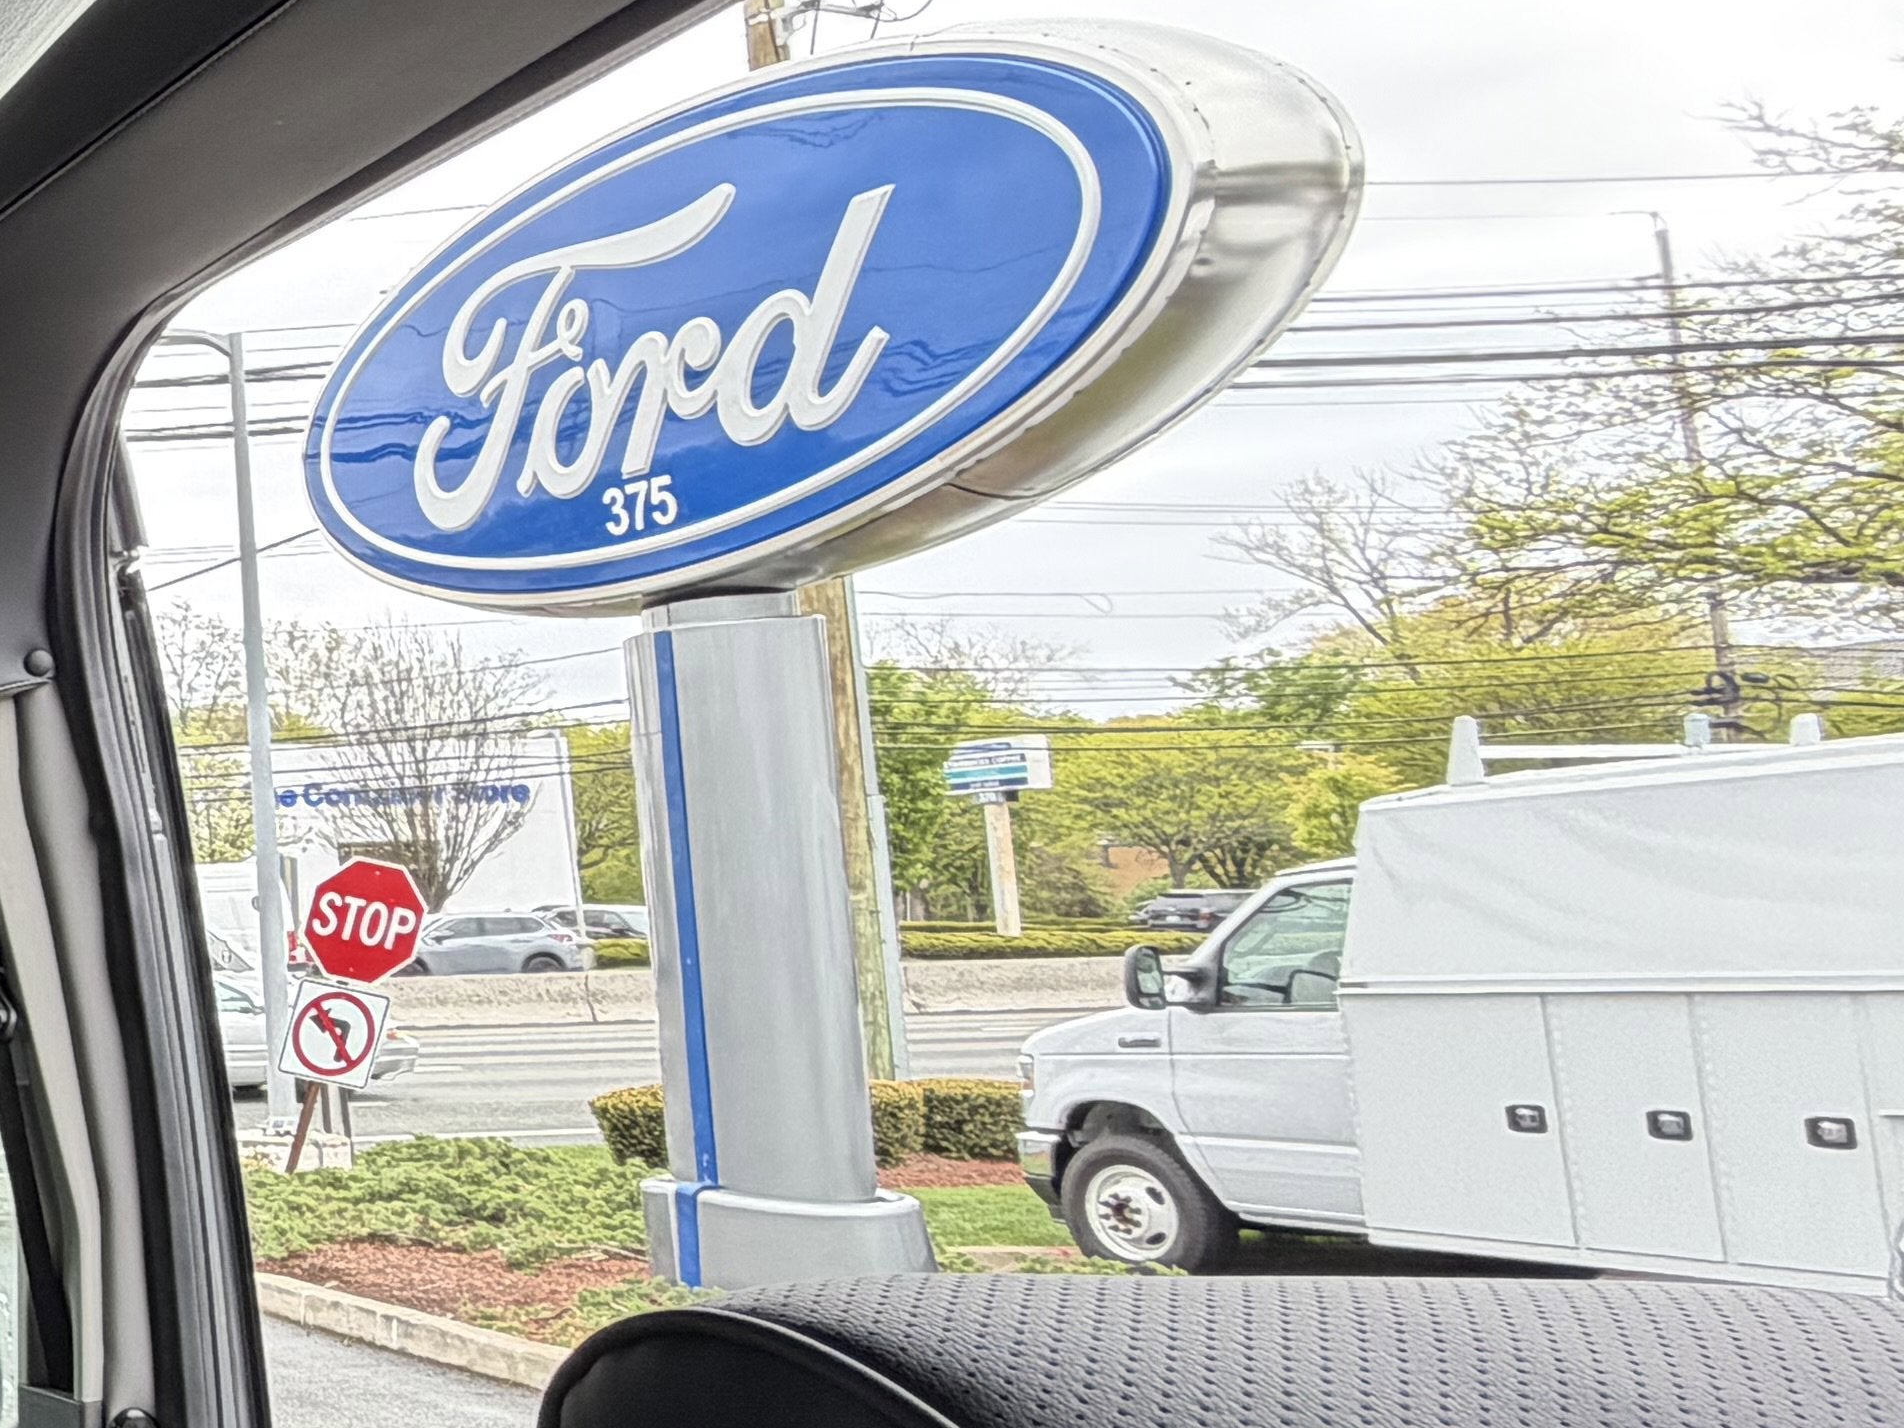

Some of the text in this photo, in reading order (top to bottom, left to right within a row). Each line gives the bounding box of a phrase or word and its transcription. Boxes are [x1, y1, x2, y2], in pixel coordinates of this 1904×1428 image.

[412, 183, 896, 531] Ford
[601, 473, 679, 537] 375
[311, 891, 417, 951] STOP
